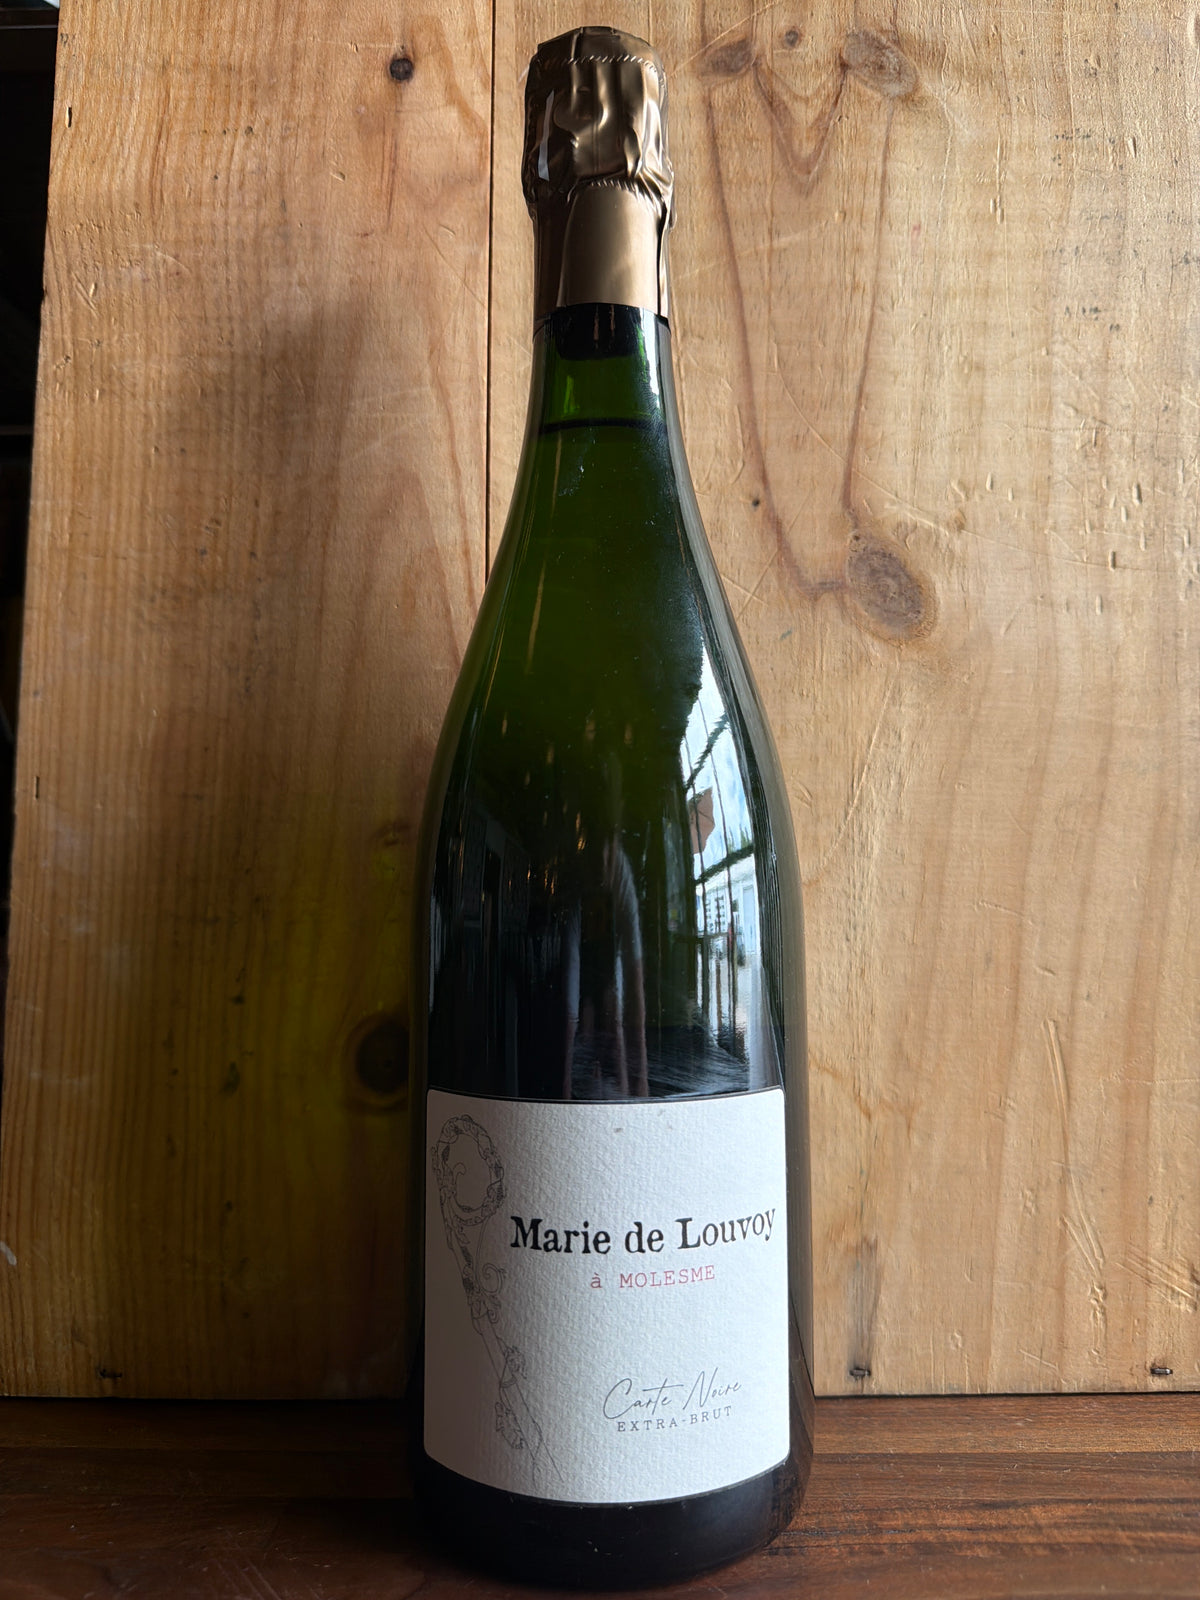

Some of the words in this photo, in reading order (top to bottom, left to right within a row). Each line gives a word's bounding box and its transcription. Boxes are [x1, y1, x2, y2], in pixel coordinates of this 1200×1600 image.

[510, 1215, 611, 1255] Marie
[624, 1221, 665, 1254] de
[676, 1207, 777, 1250] Louvoy
[589, 1271, 603, 1290] à
[619, 1264, 716, 1289] MOLESME
[602, 1378, 684, 1420] Carte
[682, 1367, 742, 1410] Noire
[616, 1405, 734, 1433] EXTRA-BRUT
